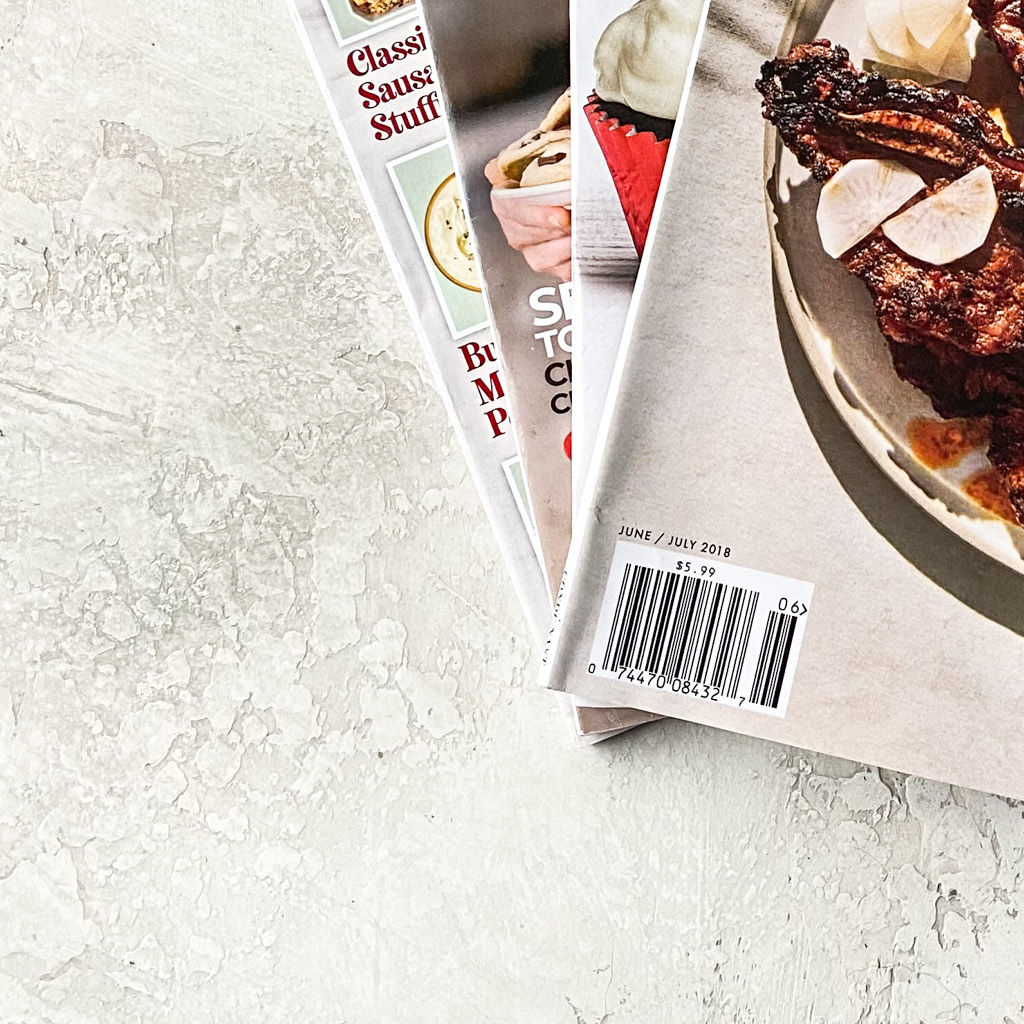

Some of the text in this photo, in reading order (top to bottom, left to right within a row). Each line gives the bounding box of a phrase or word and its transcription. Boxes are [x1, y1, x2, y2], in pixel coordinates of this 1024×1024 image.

[346, 25, 428, 77] Classi
[370, 91, 441, 141] Stuff
[544, 359, 572, 386] C
[550, 390, 572, 414] C
[618, 525, 731, 558] JUNE / JULY 2018
[675, 560, 716, 578] $5.99
[588, 662, 746, 707] 0 74470 08432 7
